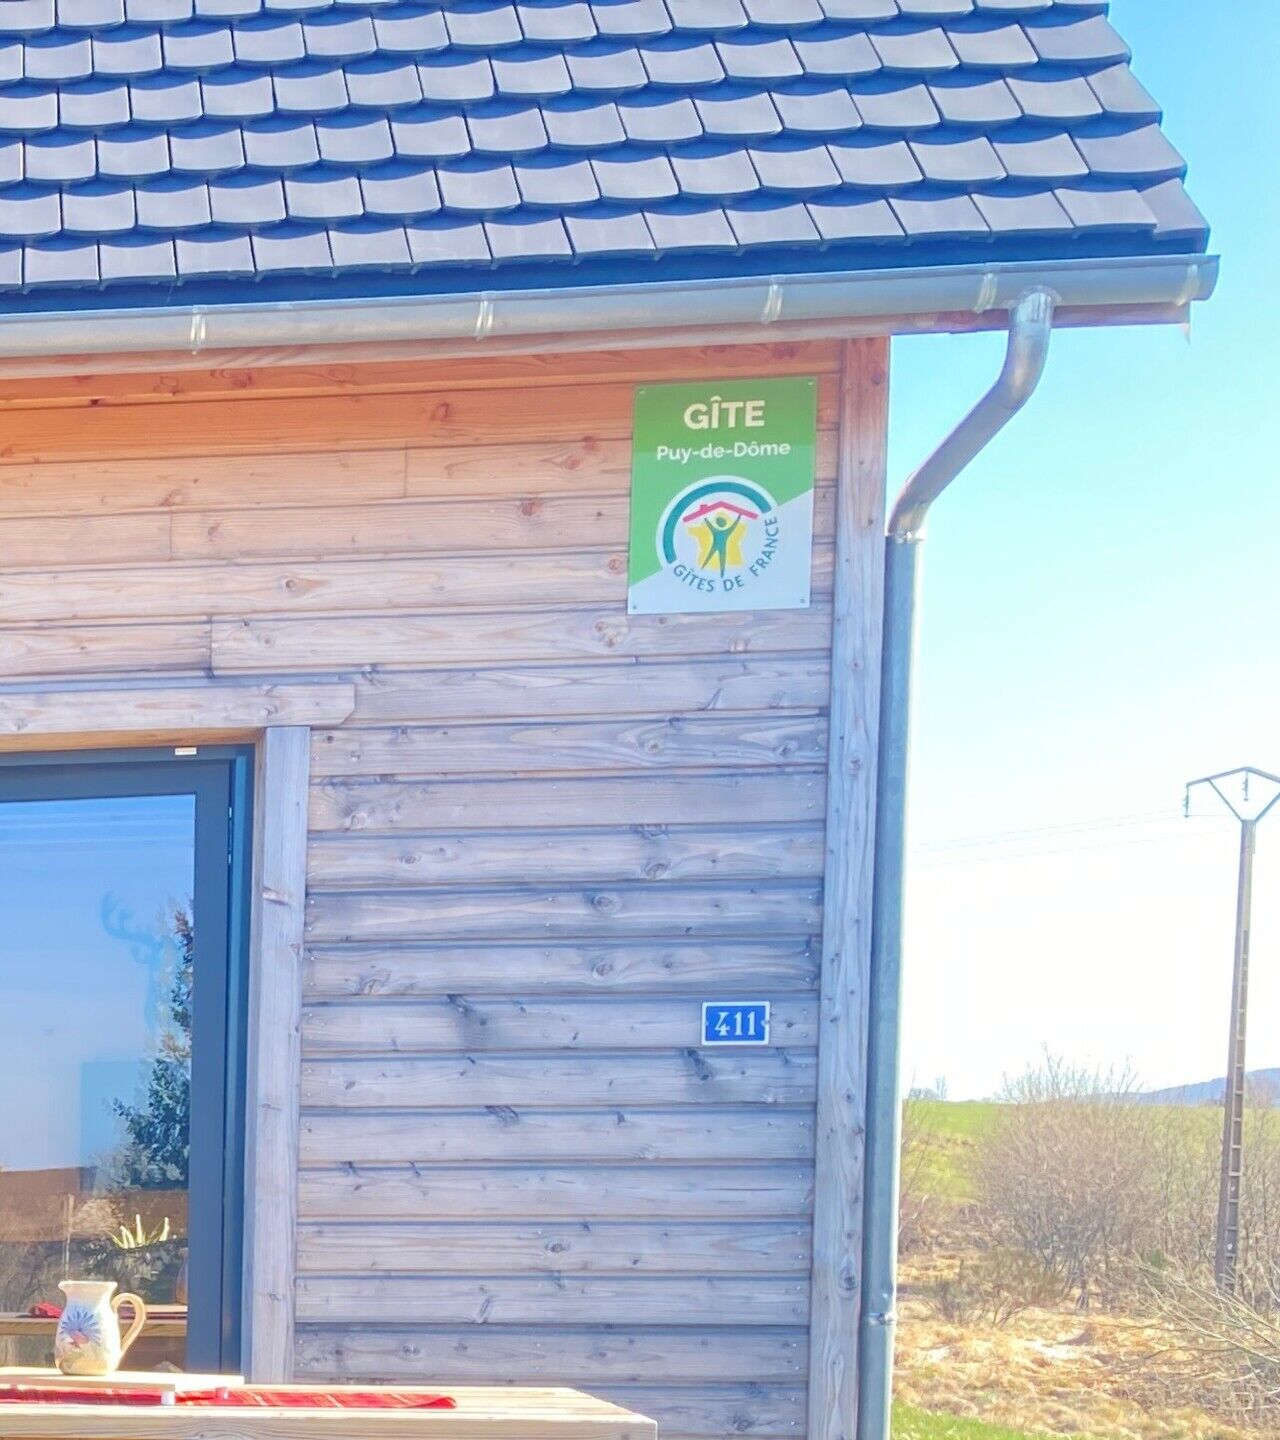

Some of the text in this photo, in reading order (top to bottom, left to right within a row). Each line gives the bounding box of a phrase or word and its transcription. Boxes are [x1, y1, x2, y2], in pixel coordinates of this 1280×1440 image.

[683, 395, 765, 429] GÎTE
[657, 441, 791, 464] Puy-de-Dôme
[723, 574, 745, 592] DE
[749, 516, 779, 577] FRANCE
[715, 1011, 756, 1036] 411
